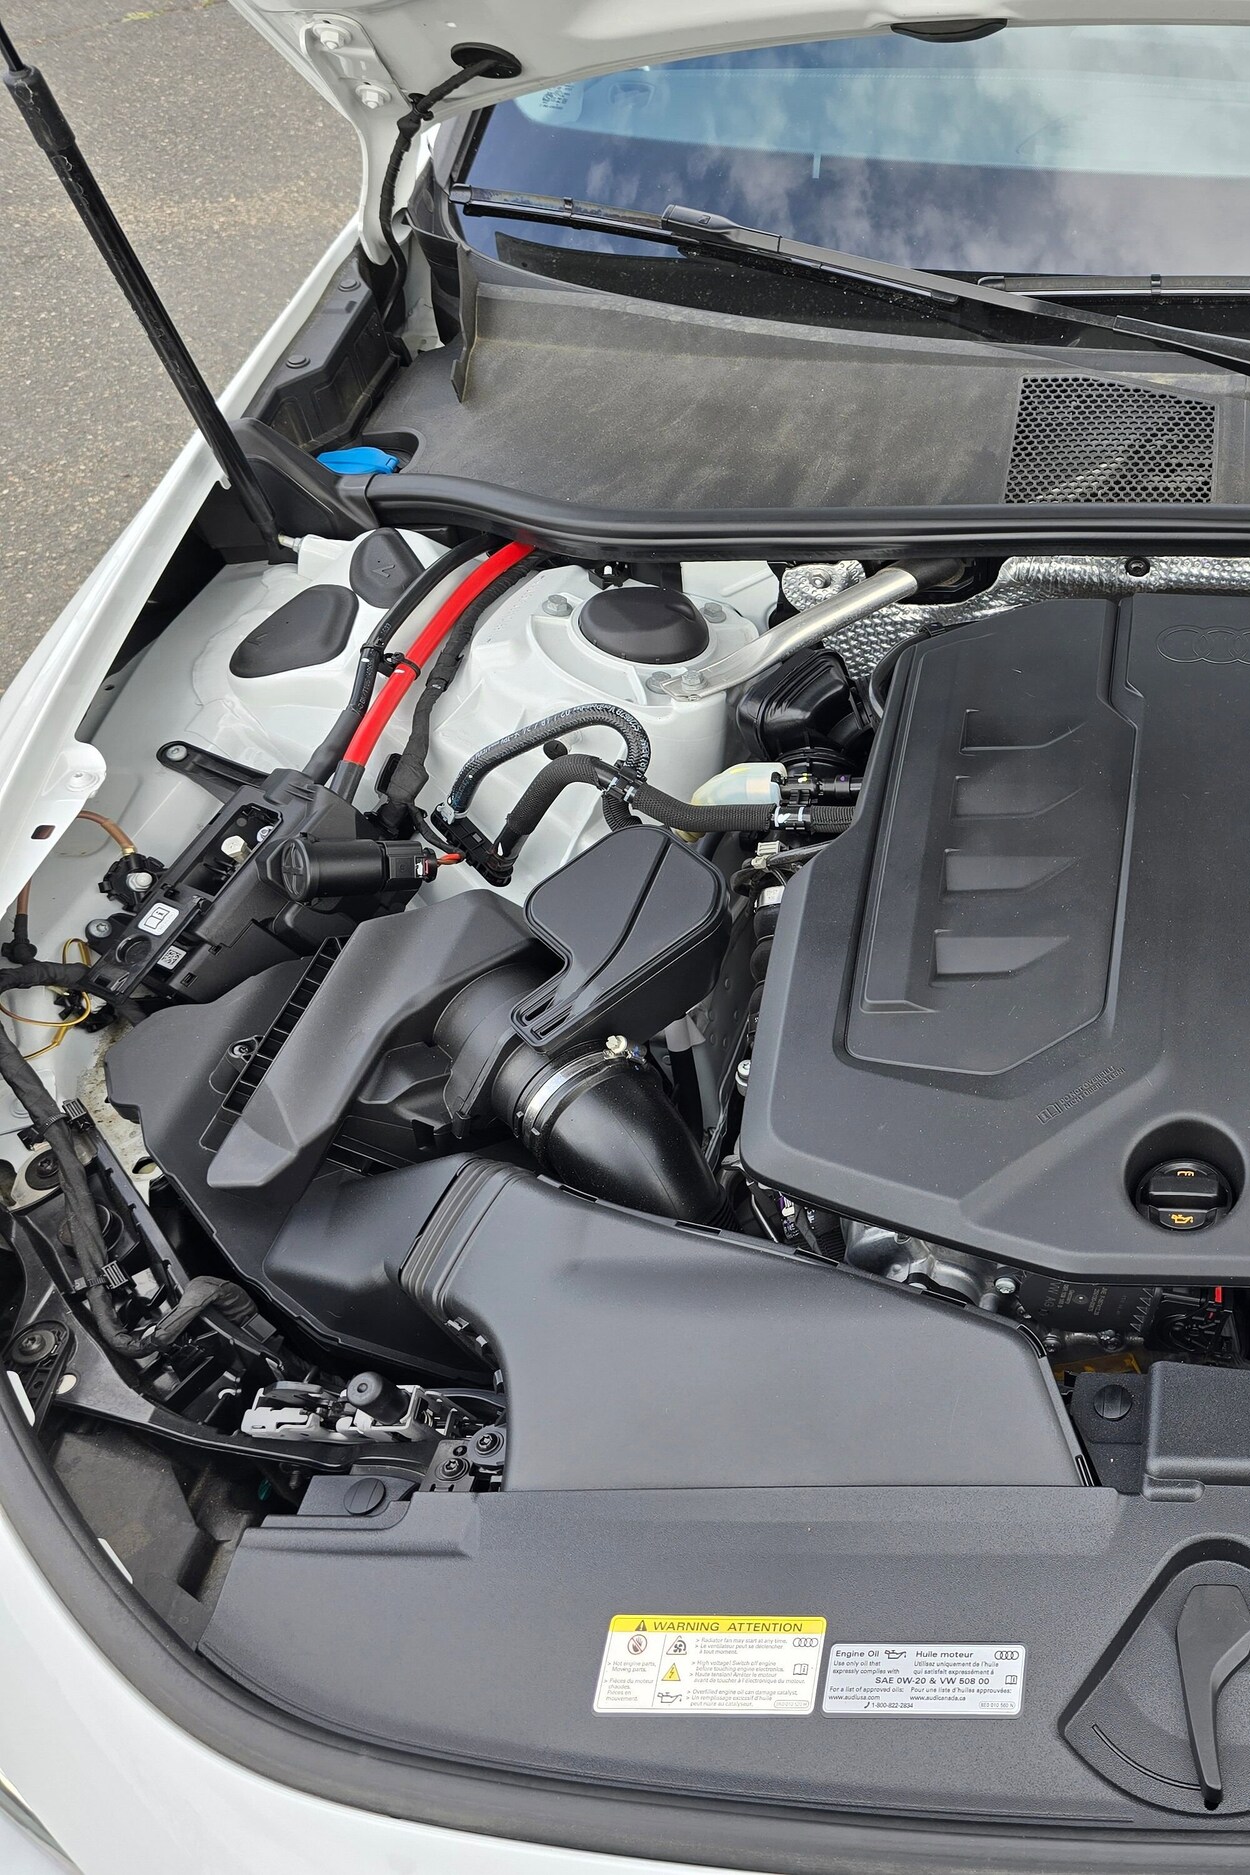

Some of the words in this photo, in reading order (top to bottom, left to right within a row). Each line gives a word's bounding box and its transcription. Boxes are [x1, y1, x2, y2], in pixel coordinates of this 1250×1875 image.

[653, 1621, 720, 1632] WARNING
[727, 1622, 803, 1632] ATTENTION
[835, 1650, 865, 1659] Engine
[867, 1650, 880, 1658] Oil
[915, 1650, 938, 1658] Huile
[846, 1660, 859, 1668] only
[936, 1661, 972, 1669] uniquement
[860, 1668, 886, 1676] complies
[875, 1676, 894, 1685] SAE
[896, 1677, 926, 1685] 0W-20
[929, 1677, 937, 1685] &
[939, 1677, 957, 1685] VW
[959, 1677, 976, 1685] 508
[978, 1677, 990, 1685] 00
